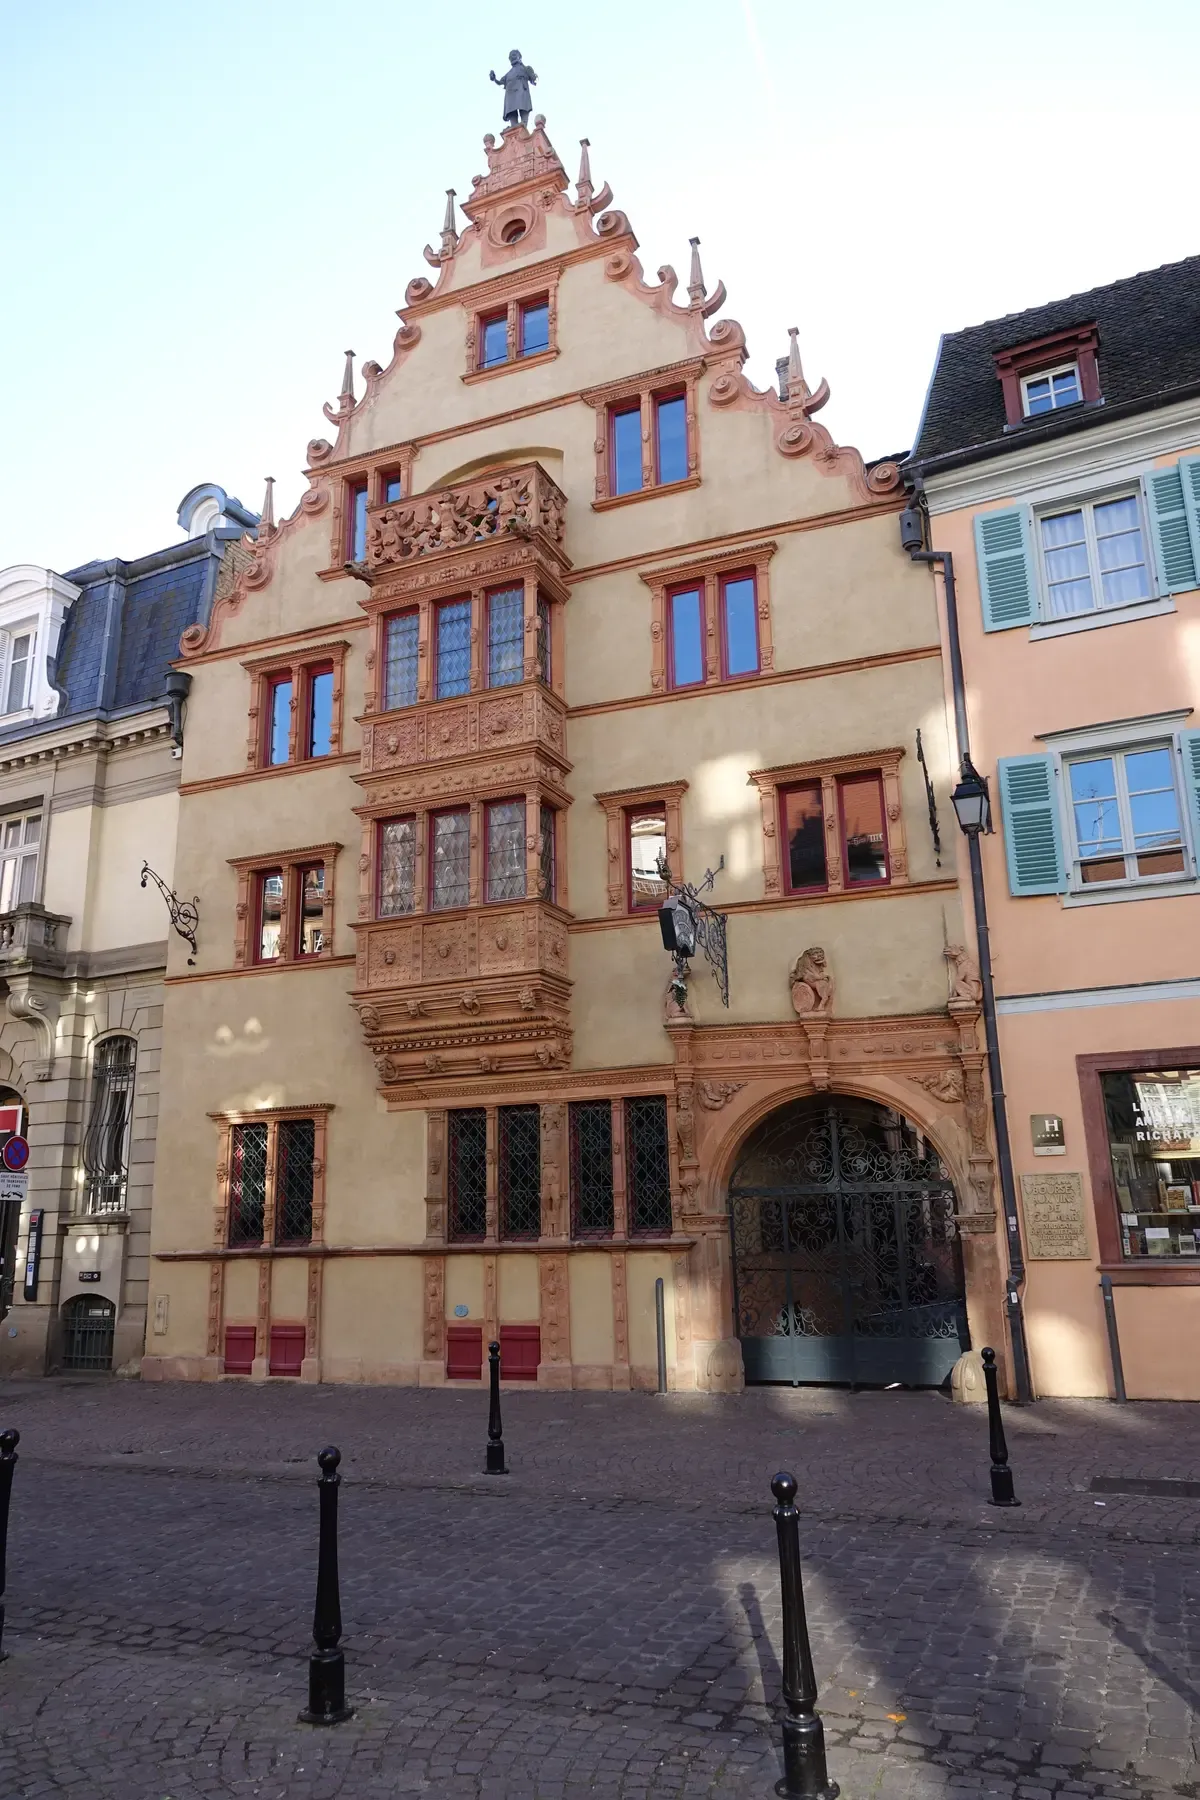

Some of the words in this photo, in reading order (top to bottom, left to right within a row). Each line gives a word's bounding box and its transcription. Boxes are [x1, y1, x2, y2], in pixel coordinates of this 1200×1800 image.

[1045, 1119, 1059, 1131] H
[1032, 1185, 1072, 1195] BOURSE
[1034, 1195, 1053, 1204] AUX
[1055, 1194, 1075, 1203] VINS
[1047, 1204, 1061, 1213] DE
